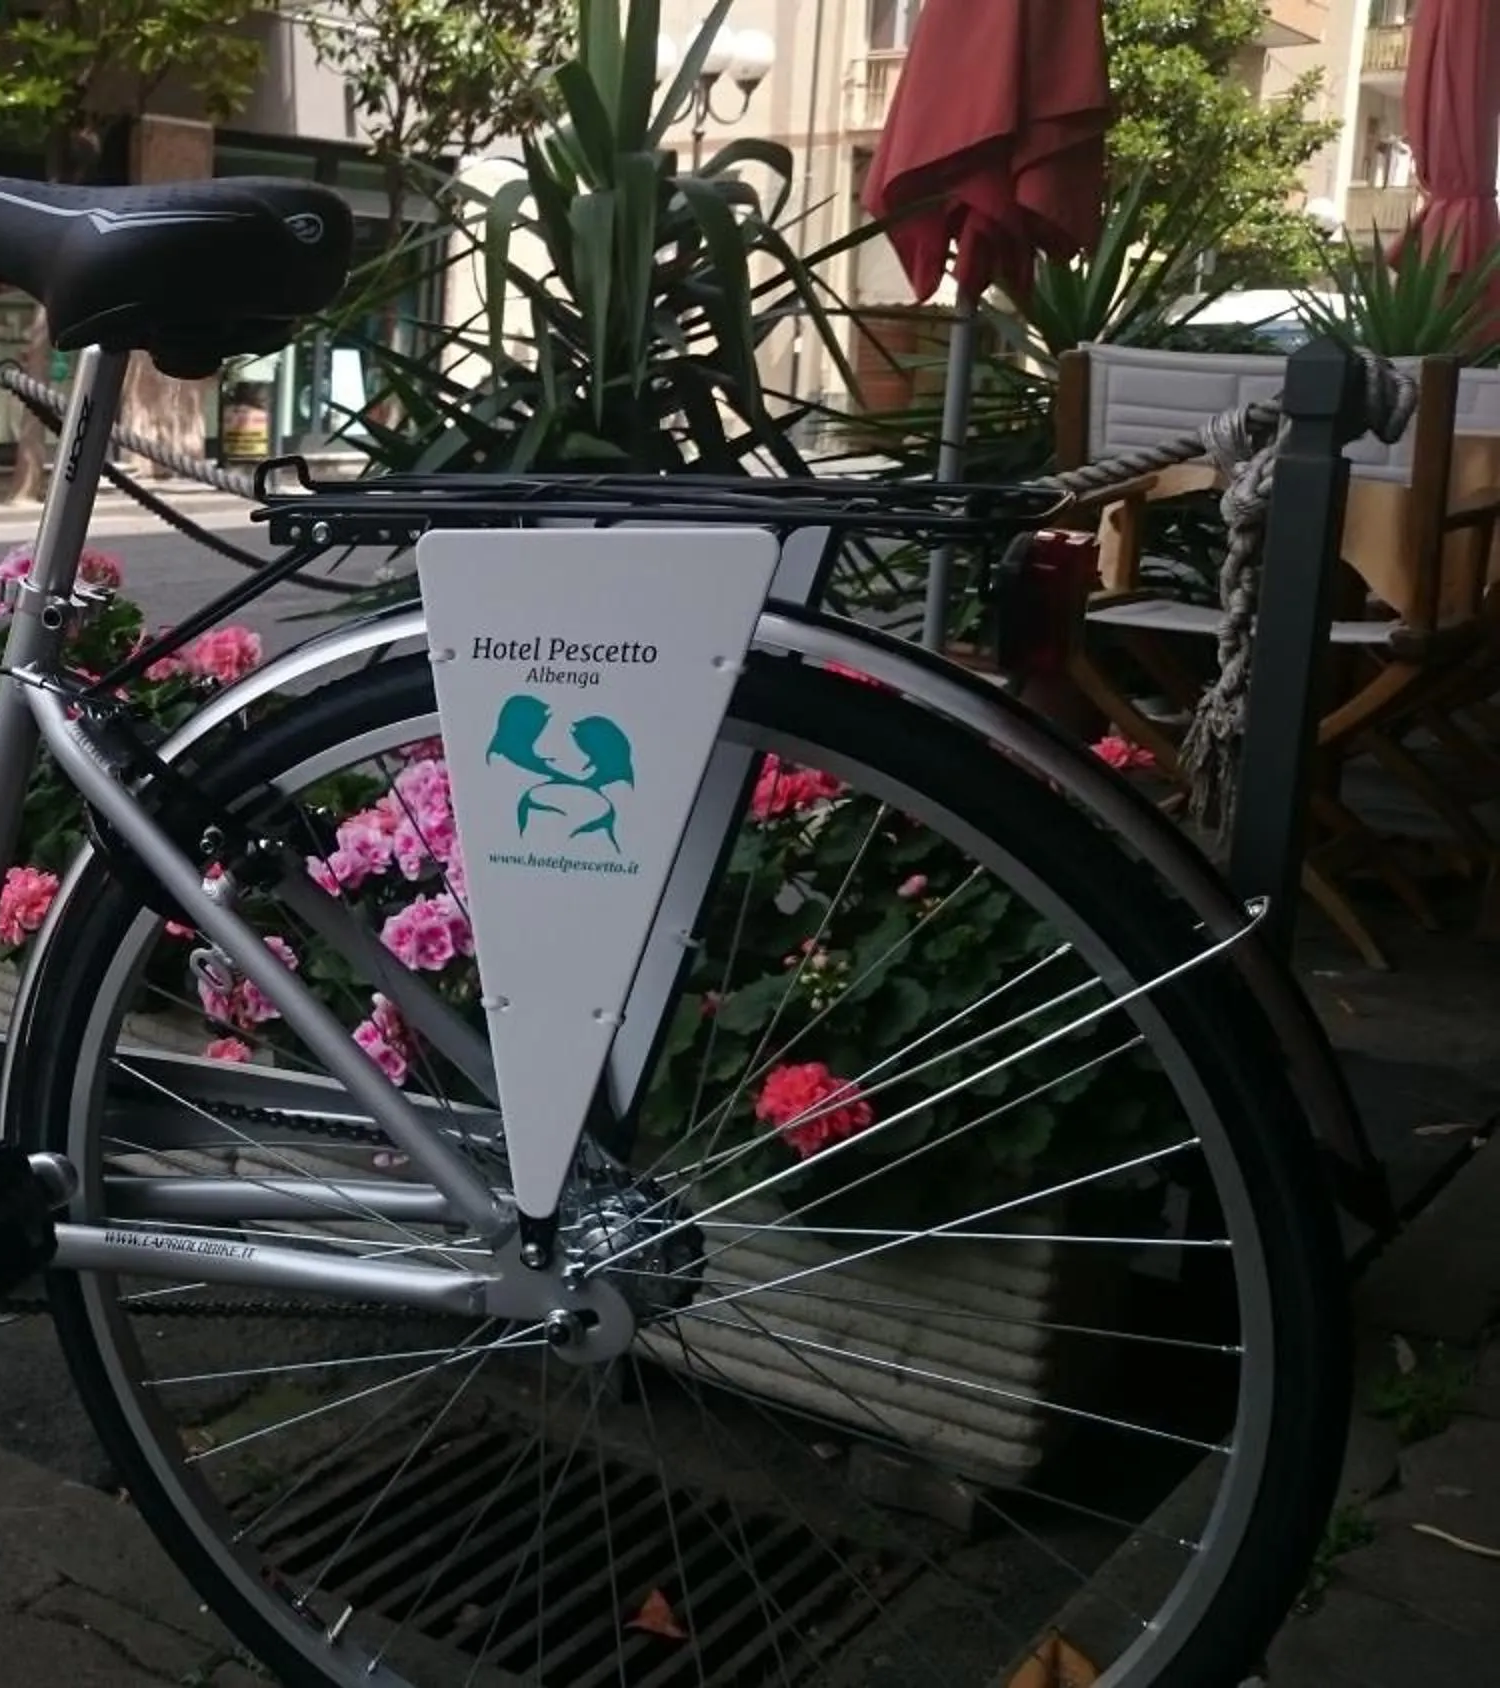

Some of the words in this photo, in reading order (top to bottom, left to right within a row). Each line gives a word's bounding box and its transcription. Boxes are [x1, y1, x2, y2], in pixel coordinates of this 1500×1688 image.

[472, 637, 542, 661] Hotel
[548, 638, 658, 664] Pescetto
[525, 667, 600, 689] Albenga
[489, 852, 639, 875] www.hotelpescetto.it
